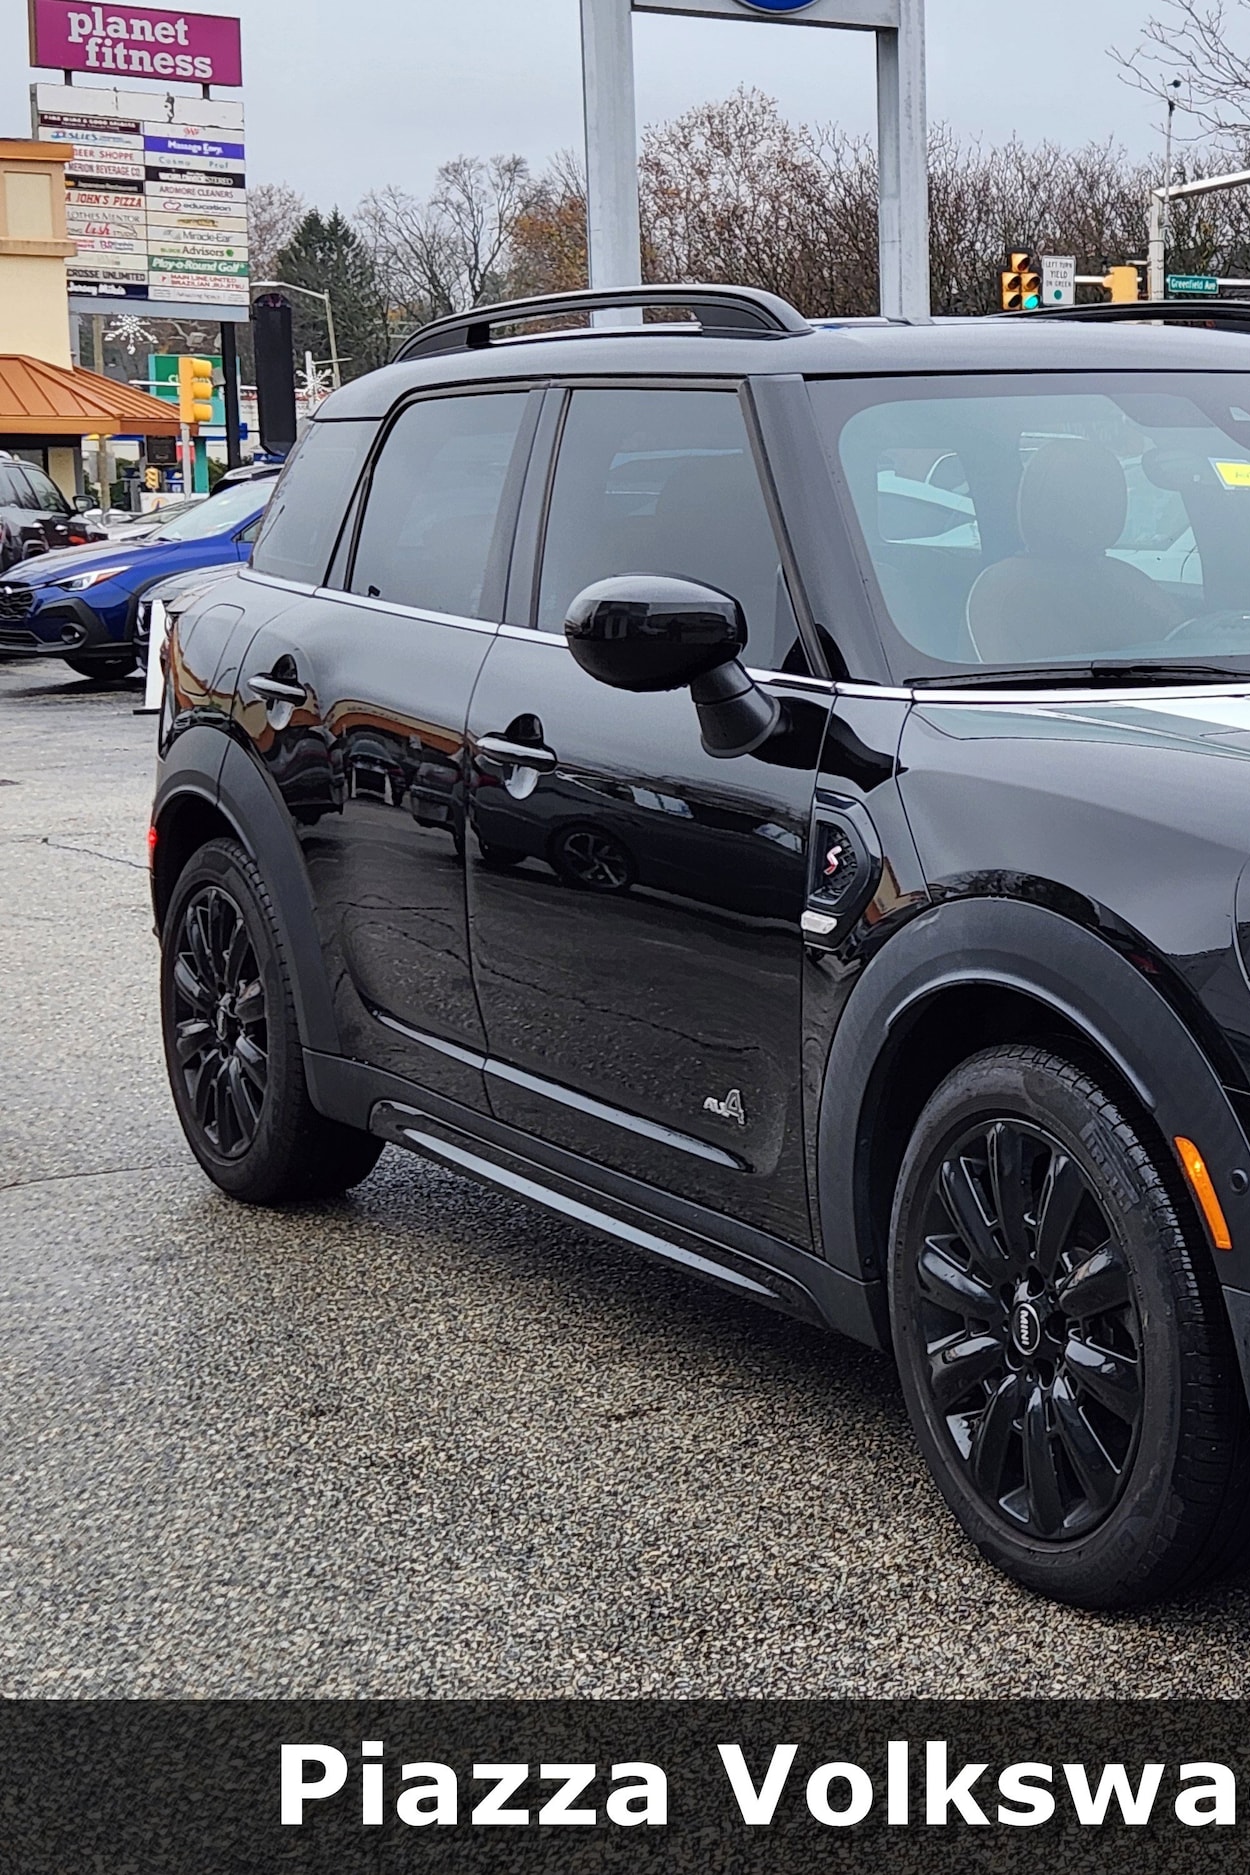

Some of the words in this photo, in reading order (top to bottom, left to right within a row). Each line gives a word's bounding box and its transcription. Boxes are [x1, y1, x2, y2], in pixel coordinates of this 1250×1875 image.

[67, 6, 189, 45] planet
[85, 37, 213, 78] fitness
[99, 149, 134, 160] SHOPPE
[95, 164, 130, 176] BEVERAGE
[159, 186, 195, 195] ARDMORE
[197, 188, 234, 199] CLEANERS
[76, 192, 110, 205] JOHN'S
[113, 196, 142, 207] PIZZA
[183, 203, 232, 211] education
[102, 213, 140, 222] MENTOR
[182, 231, 234, 242] Miracle-Ear
[182, 246, 225, 257] Advisors
[1044, 261, 1059, 269] LEFT
[1060, 261, 1073, 269] TURN
[102, 270, 146, 281] UNLIMITED
[1050, 270, 1068, 279] YIELD
[171, 279, 210, 288] BRAZILIAN
[1054, 280, 1072, 288] GREEN
[1171, 278, 1204, 290] Greenfield
[1204, 280, 1217, 290] Ave
[1020, 1309, 1030, 1345] MINI
